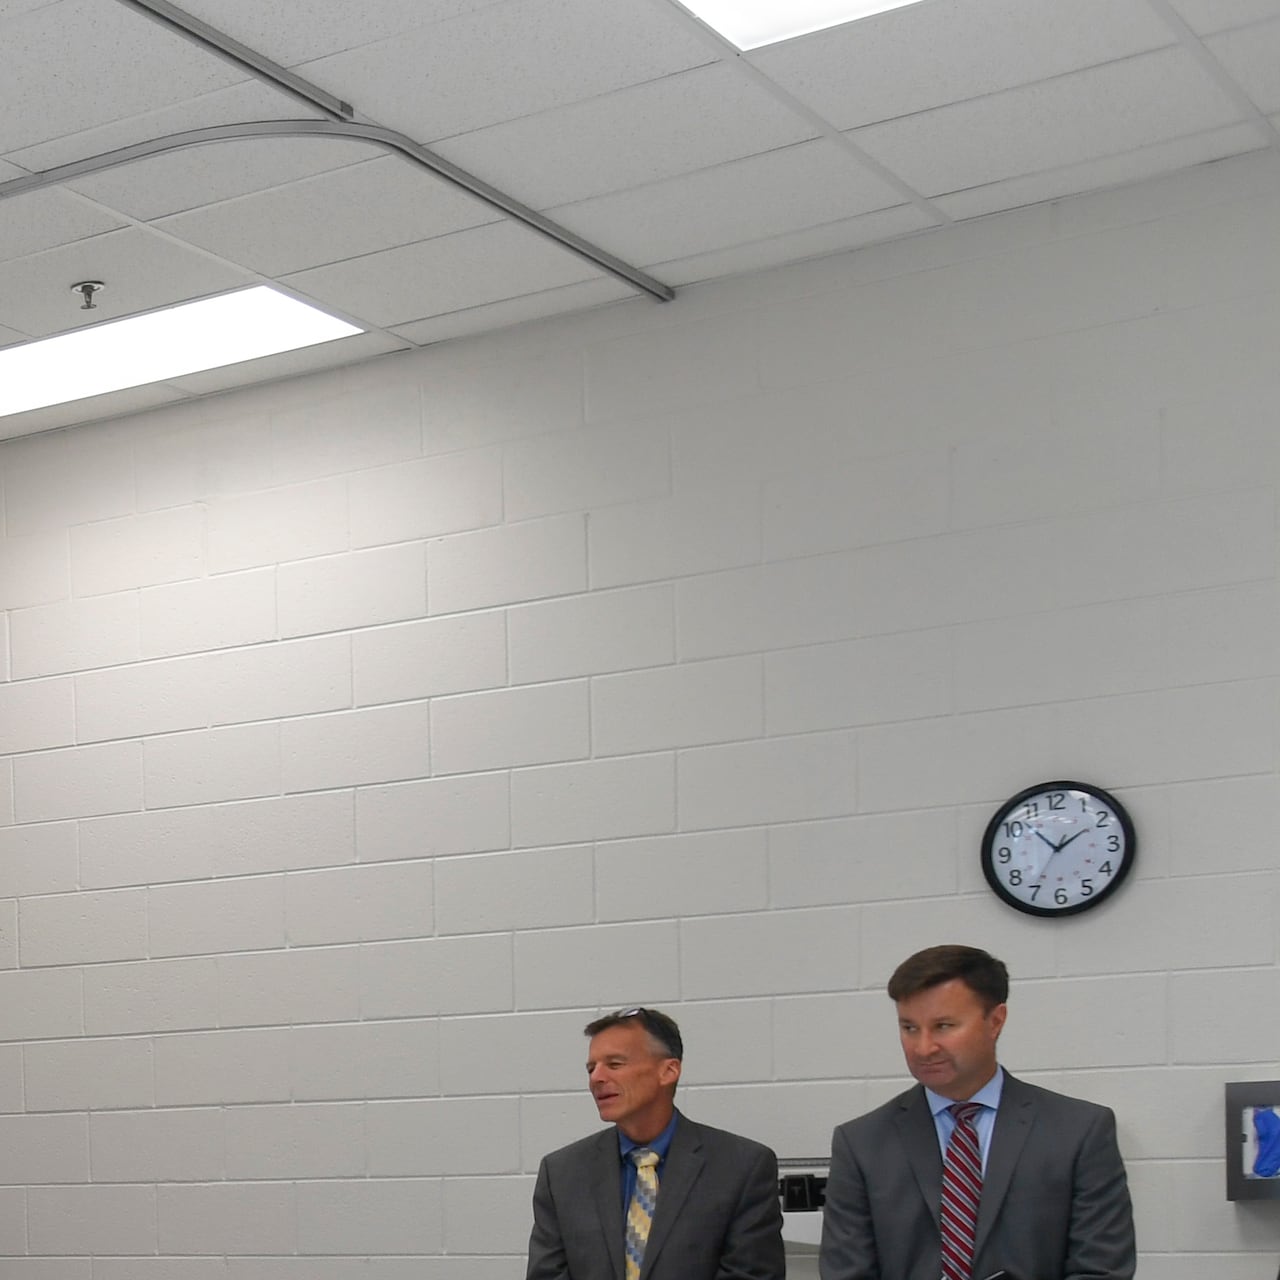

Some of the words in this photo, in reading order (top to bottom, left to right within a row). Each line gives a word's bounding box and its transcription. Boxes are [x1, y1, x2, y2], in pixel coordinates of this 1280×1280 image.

[1023, 802, 1039, 819] 11
[1045, 793, 1066, 811] 12
[1078, 797, 1087, 813] 1
[1095, 810, 1110, 828] 2
[1003, 820, 1023, 838] 10
[1106, 834, 1121, 852] 3
[998, 846, 1012, 864] 9
[1008, 869, 1023, 886] 8
[1098, 860, 1113, 877] 4
[1027, 884, 1042, 902] 7
[1054, 887, 1068, 905] 6
[1080, 878, 1094, 896] 5
